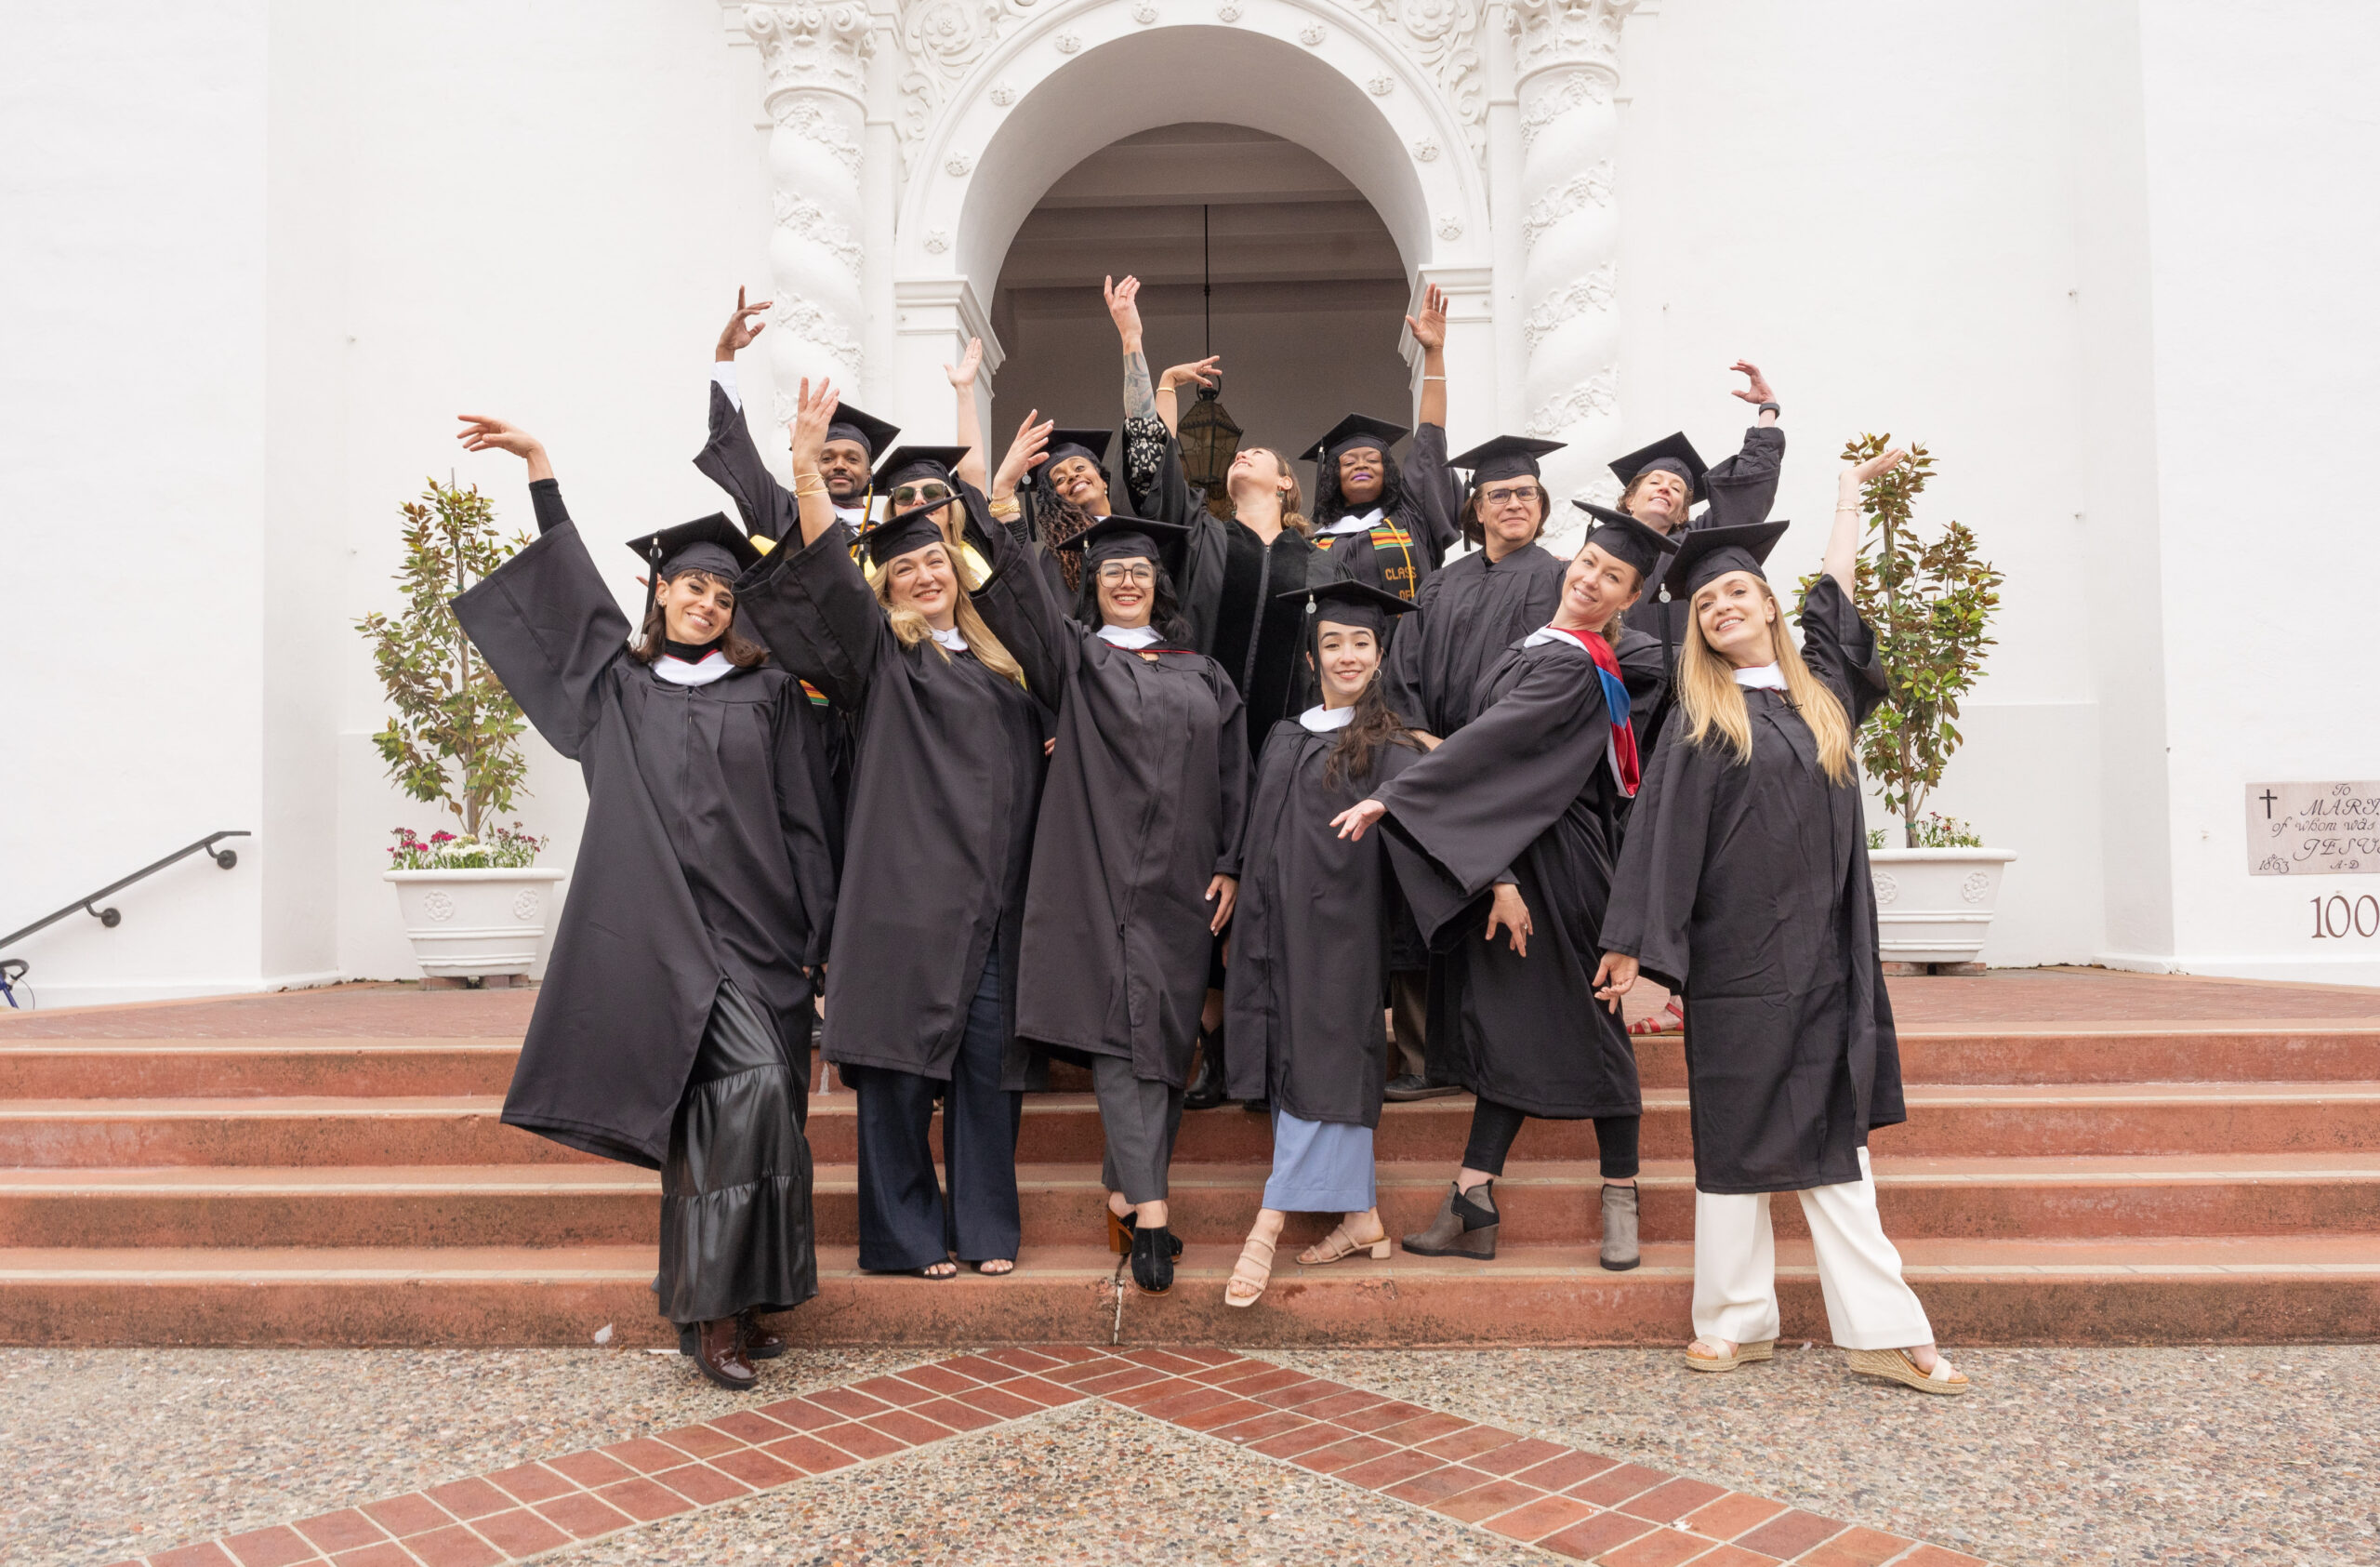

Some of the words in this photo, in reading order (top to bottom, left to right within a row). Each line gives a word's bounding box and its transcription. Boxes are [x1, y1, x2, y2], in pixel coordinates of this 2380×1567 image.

[1384, 565, 1417, 581] CLASS
[2332, 783, 2351, 796] To
[2271, 817, 2293, 837] of
[2295, 818, 2336, 831] whom
[2344, 817, 2376, 831] was
[2293, 838, 2380, 861] JESU
[2309, 895, 2380, 938] 100
